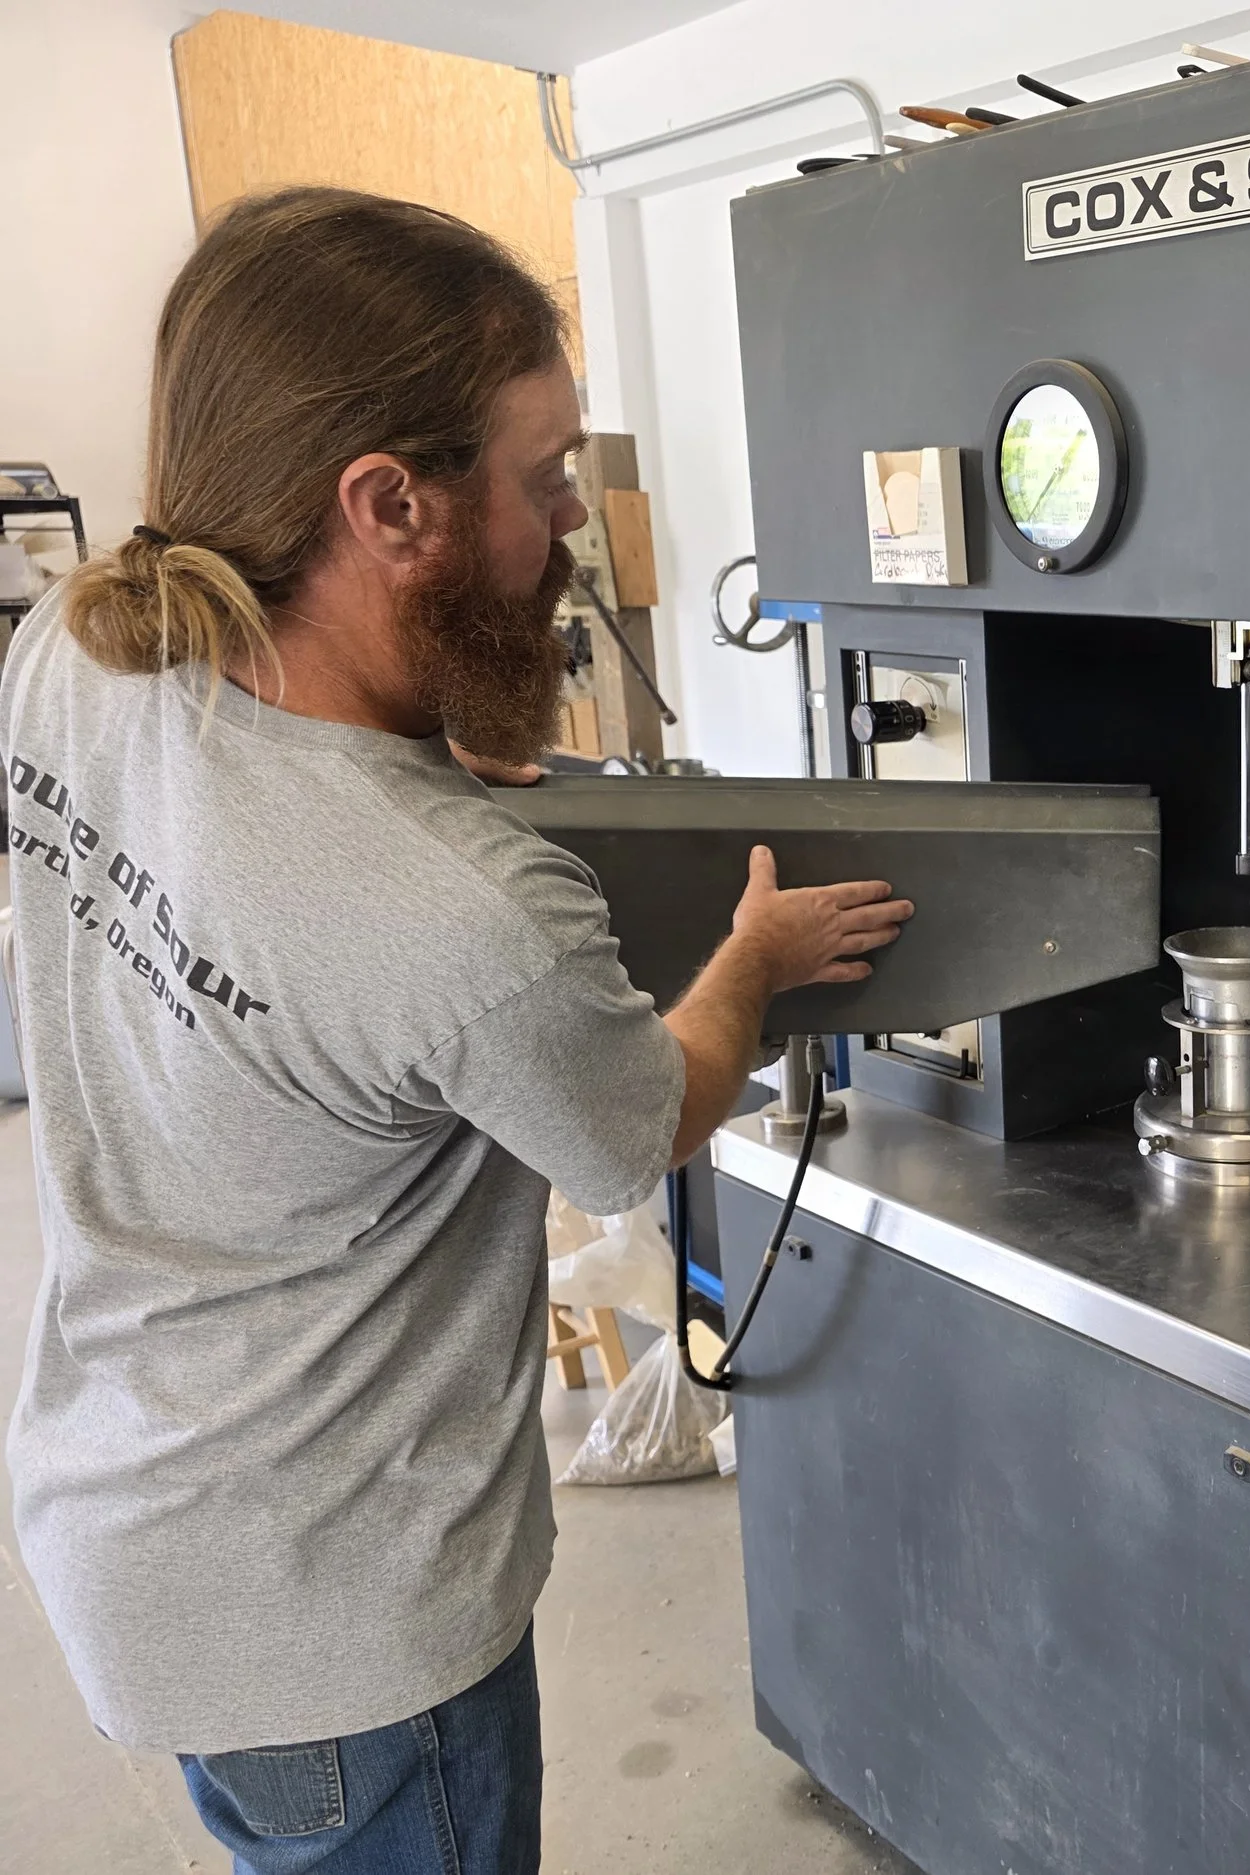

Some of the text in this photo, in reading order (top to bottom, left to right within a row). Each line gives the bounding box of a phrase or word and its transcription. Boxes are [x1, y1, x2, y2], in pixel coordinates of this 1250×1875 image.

[1045, 170, 1173, 239] COX
[1189, 160, 1233, 212] &
[874, 549, 941, 562] FILTER PAPERS
[10, 755, 271, 1022] oue of Sour
[107, 918, 196, 1030] Oregon
